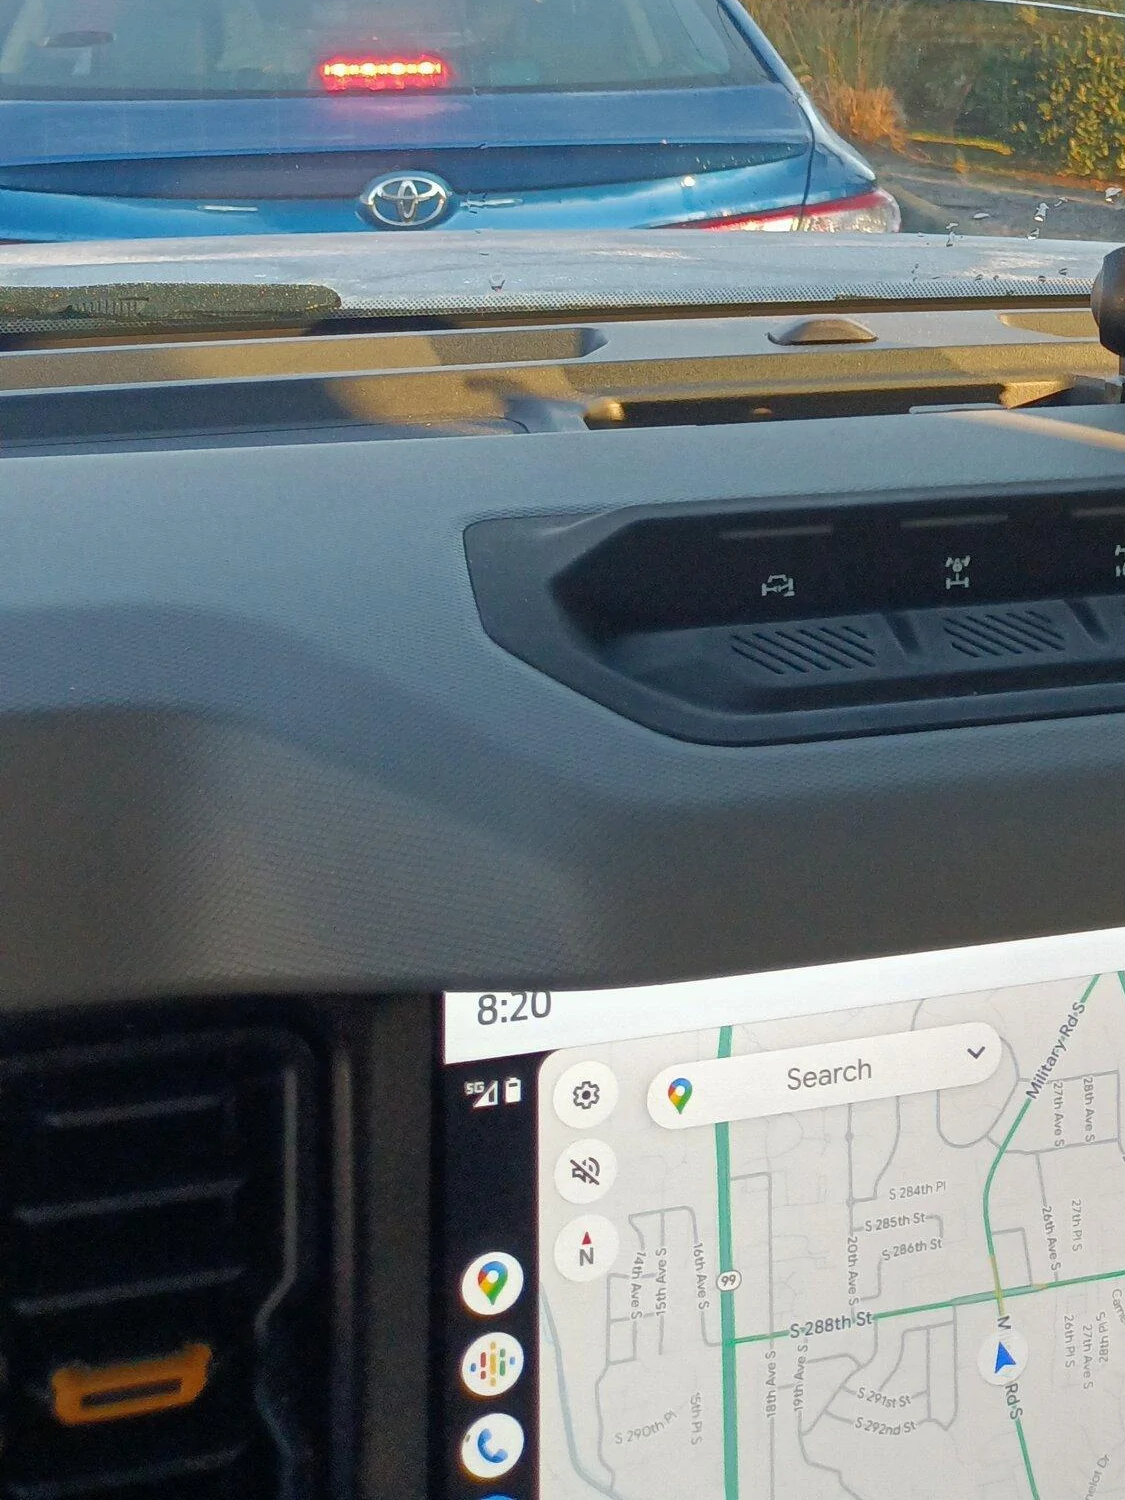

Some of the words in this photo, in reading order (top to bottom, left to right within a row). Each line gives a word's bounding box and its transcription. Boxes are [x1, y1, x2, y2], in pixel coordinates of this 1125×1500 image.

[477, 991, 551, 1025] 8:20
[1026, 1039, 1067, 1100] Military
[1059, 1014, 1078, 1038] Rd
[1072, 1001, 1085, 1015] S
[787, 1058, 872, 1090] Search
[464, 1081, 485, 1095] 5G
[1053, 1081, 1064, 1107] 27th
[1083, 1077, 1093, 1103] 28th
[1054, 1110, 1064, 1136] Ave
[1084, 1107, 1094, 1132] Ave
[1055, 1139, 1065, 1147] S
[1085, 1134, 1095, 1142] S
[889, 1188, 897, 1200] S
[900, 1183, 933, 1199] 284th
[865, 1220, 873, 1232] S
[875, 1214, 911, 1231] 285th
[913, 1212, 926, 1225] St
[1042, 1206, 1053, 1236] 26th
[1072, 1200, 1082, 1226] 27th
[579, 1247, 593, 1266] N
[656, 1248, 666, 1256] S
[694, 1243, 704, 1271] 16th
[847, 1236, 858, 1268] 20th
[882, 1249, 890, 1261] S
[893, 1241, 927, 1258] 286th
[930, 1238, 943, 1251] St
[1047, 1237, 1058, 1261] Ave
[1073, 1243, 1082, 1252] S
[656, 1260, 666, 1285] Ave
[1051, 1262, 1061, 1271] S
[696, 1273, 707, 1298] Ave
[721, 1275, 736, 1286] 99
[848, 1270, 858, 1295] Ave
[631, 1283, 642, 1307] Ave
[656, 1289, 666, 1316] 15th
[699, 1301, 709, 1310] S
[849, 1297, 859, 1306] S
[631, 1311, 642, 1319] S
[790, 1324, 800, 1339] S
[804, 1316, 851, 1336] 288th
[856, 1311, 873, 1327] St
[1064, 1315, 1074, 1343] 26th
[1082, 1324, 1092, 1352] 27th
[765, 1350, 776, 1359] S
[798, 1344, 808, 1353] S
[766, 1362, 776, 1387] Ave
[795, 1355, 805, 1382] Ave
[1065, 1360, 1075, 1368] S
[1083, 1355, 1093, 1379] Ave
[1005, 1383, 1019, 1405] Rd
[1083, 1381, 1093, 1389] S
[766, 1391, 776, 1419] 18th
[794, 1386, 804, 1412] 19th
[857, 1388, 865, 1399] S
[866, 1390, 896, 1408] 291st
[899, 1395, 911, 1407] St
[1010, 1408, 1023, 1419] S
[615, 1433, 623, 1445] S
[627, 1421, 665, 1443] 290th
[855, 1417, 863, 1429] S
[863, 1419, 900, 1436] 292nd
[903, 1420, 916, 1433] St
